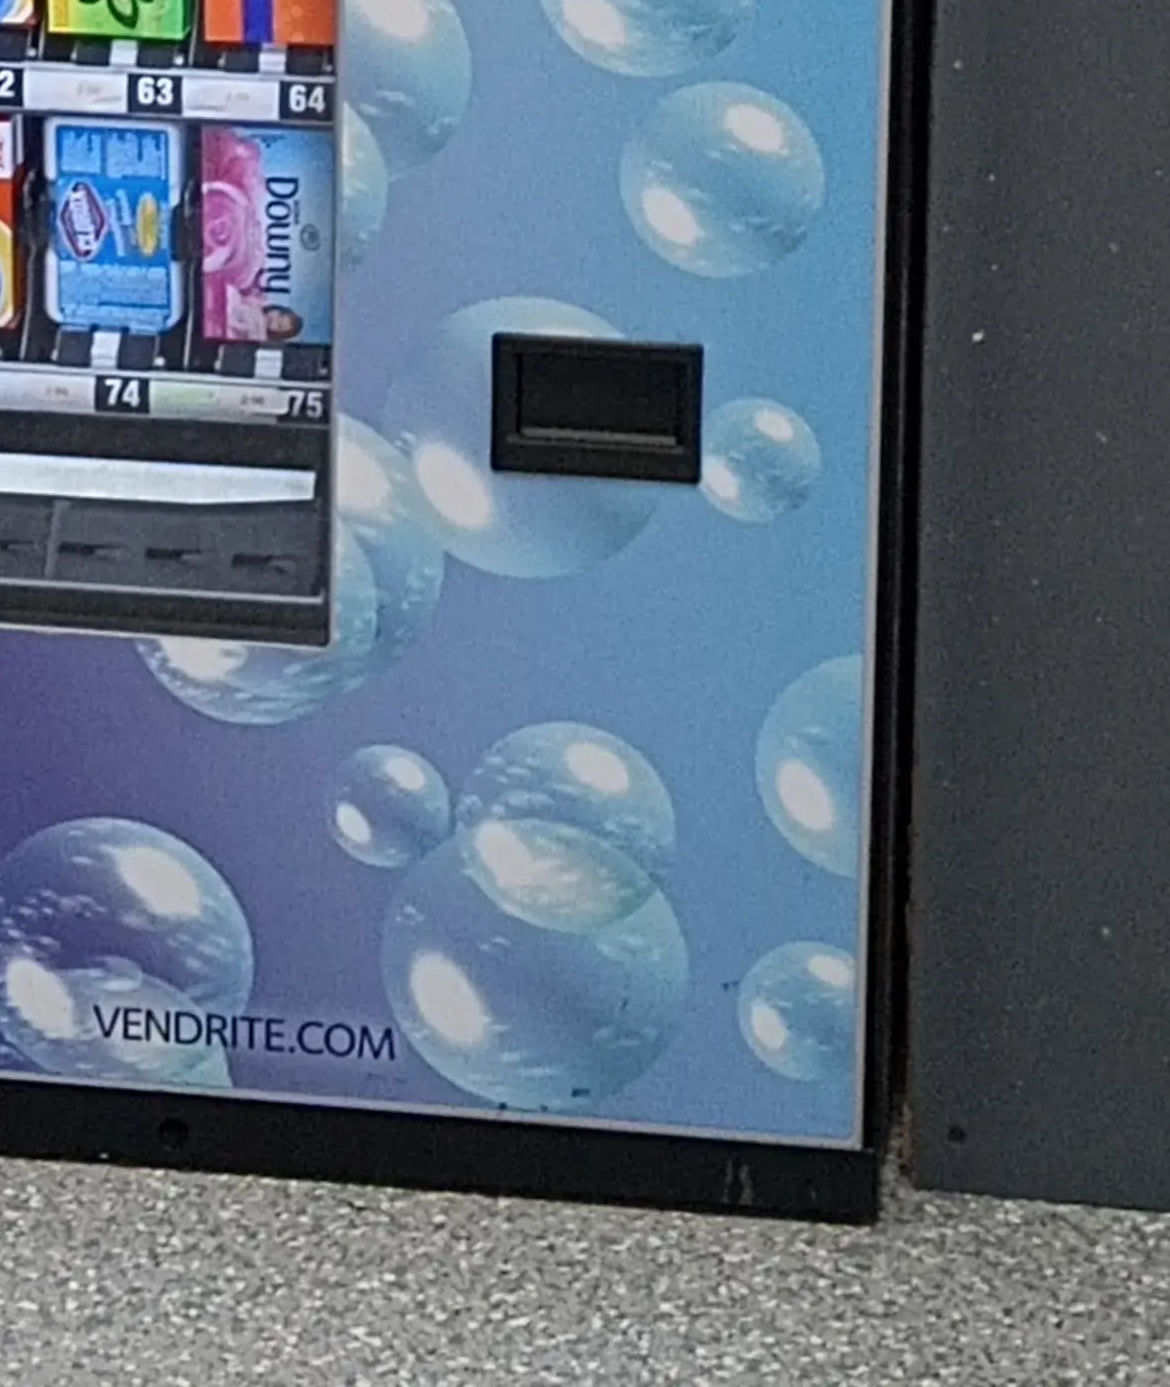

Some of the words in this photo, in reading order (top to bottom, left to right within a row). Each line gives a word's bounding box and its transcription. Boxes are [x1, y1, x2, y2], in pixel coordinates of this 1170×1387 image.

[137, 78, 173, 105] 63
[289, 85, 325, 113] 64
[253, 177, 300, 295] Downy
[105, 381, 141, 407] 74
[290, 391, 324, 418] 75
[92, 1004, 397, 1062] VENDRITE.COM
